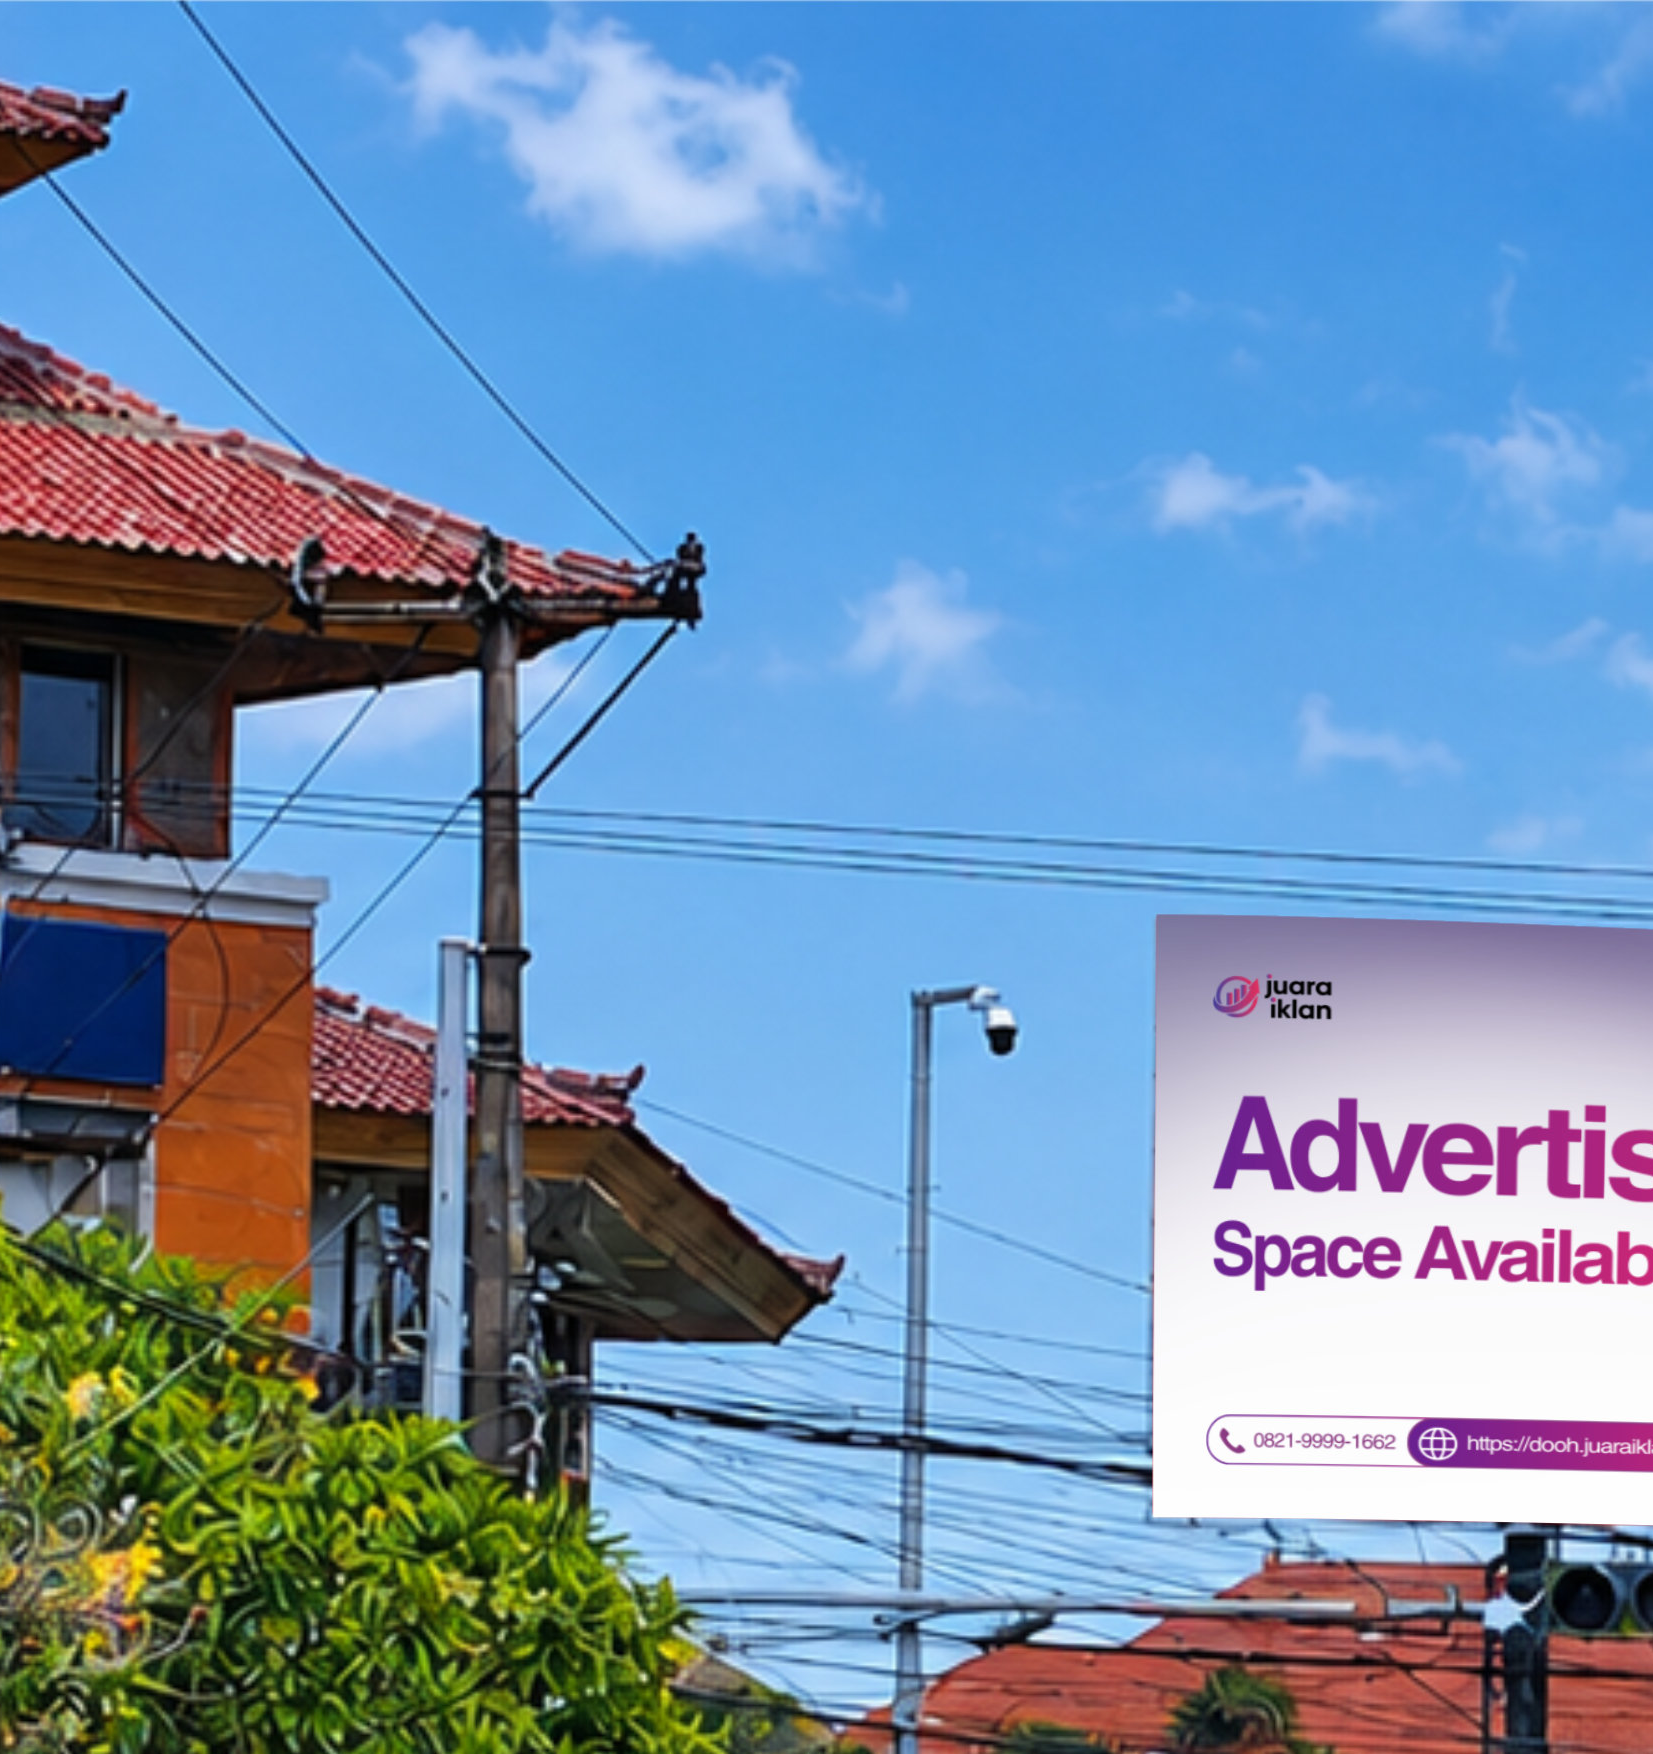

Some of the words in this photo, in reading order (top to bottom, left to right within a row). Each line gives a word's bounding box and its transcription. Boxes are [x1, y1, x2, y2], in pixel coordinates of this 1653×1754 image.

[1264, 973, 1332, 998] juara
[1270, 996, 1332, 1020] iklan
[1212, 1219, 1403, 1292] Space
[1252, 1431, 1397, 1451] 0821-9999-1662
